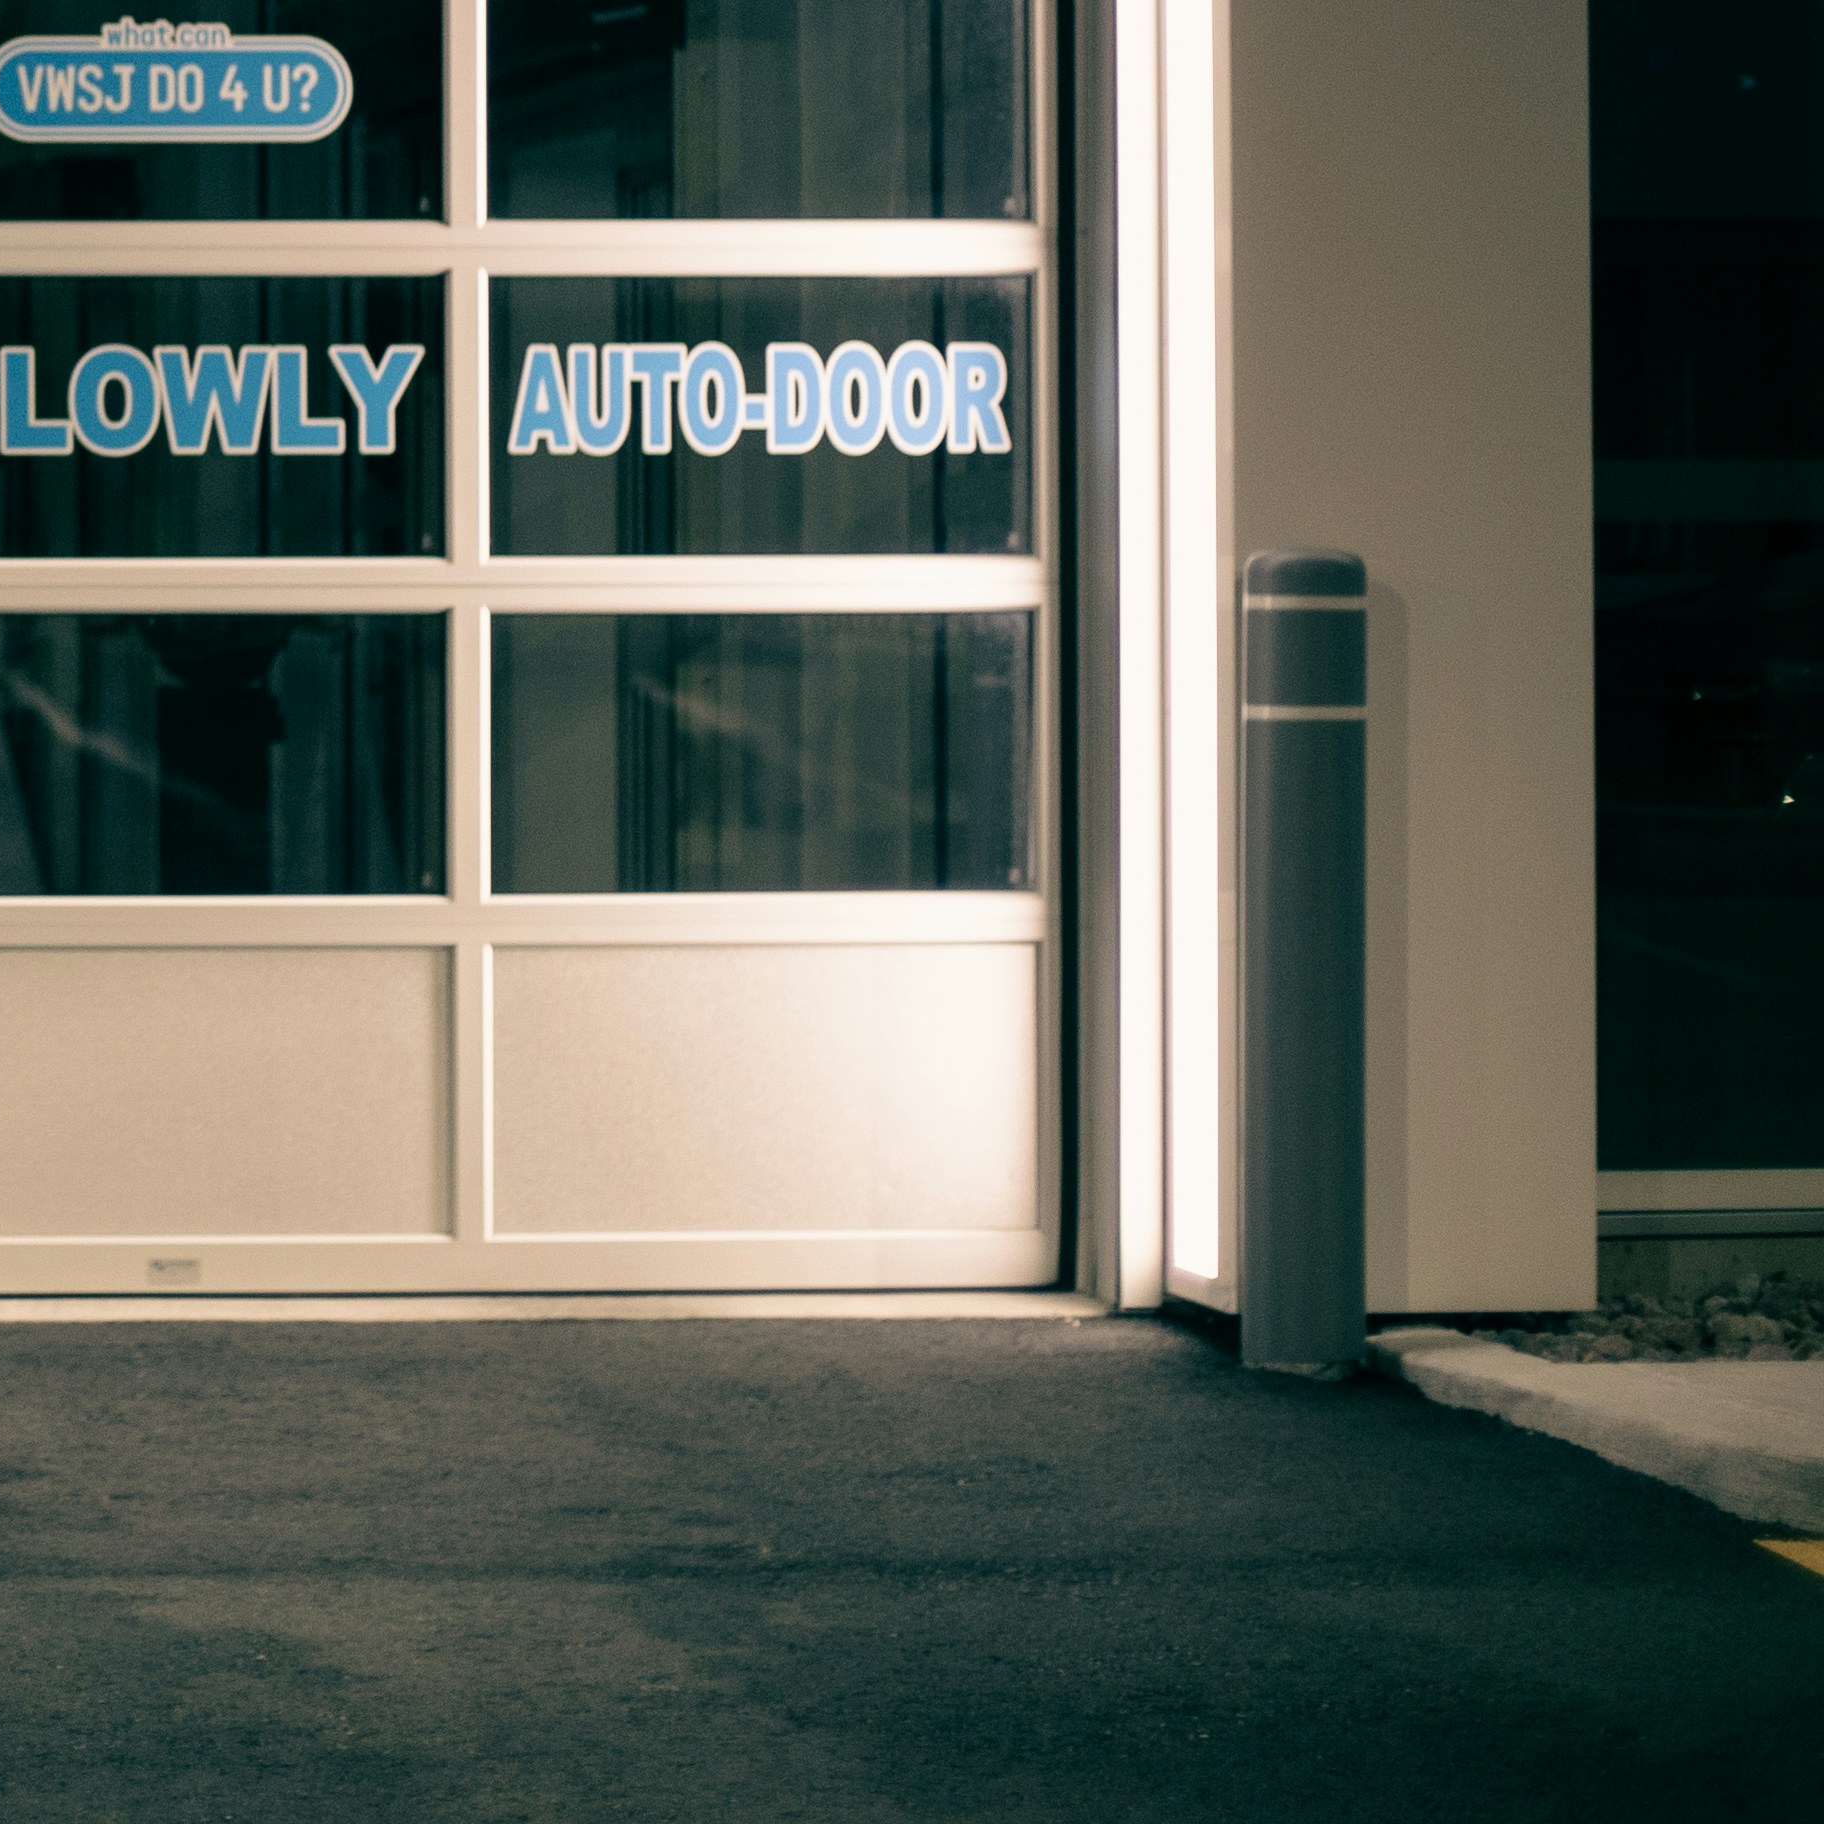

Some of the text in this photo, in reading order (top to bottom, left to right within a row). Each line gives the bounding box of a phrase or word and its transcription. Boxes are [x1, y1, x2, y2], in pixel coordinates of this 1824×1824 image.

[106, 21, 228, 48] what can
[16, 63, 320, 114] VWSJ DO 4 U?
[506, 339, 1013, 458] AUTO-DOOR
